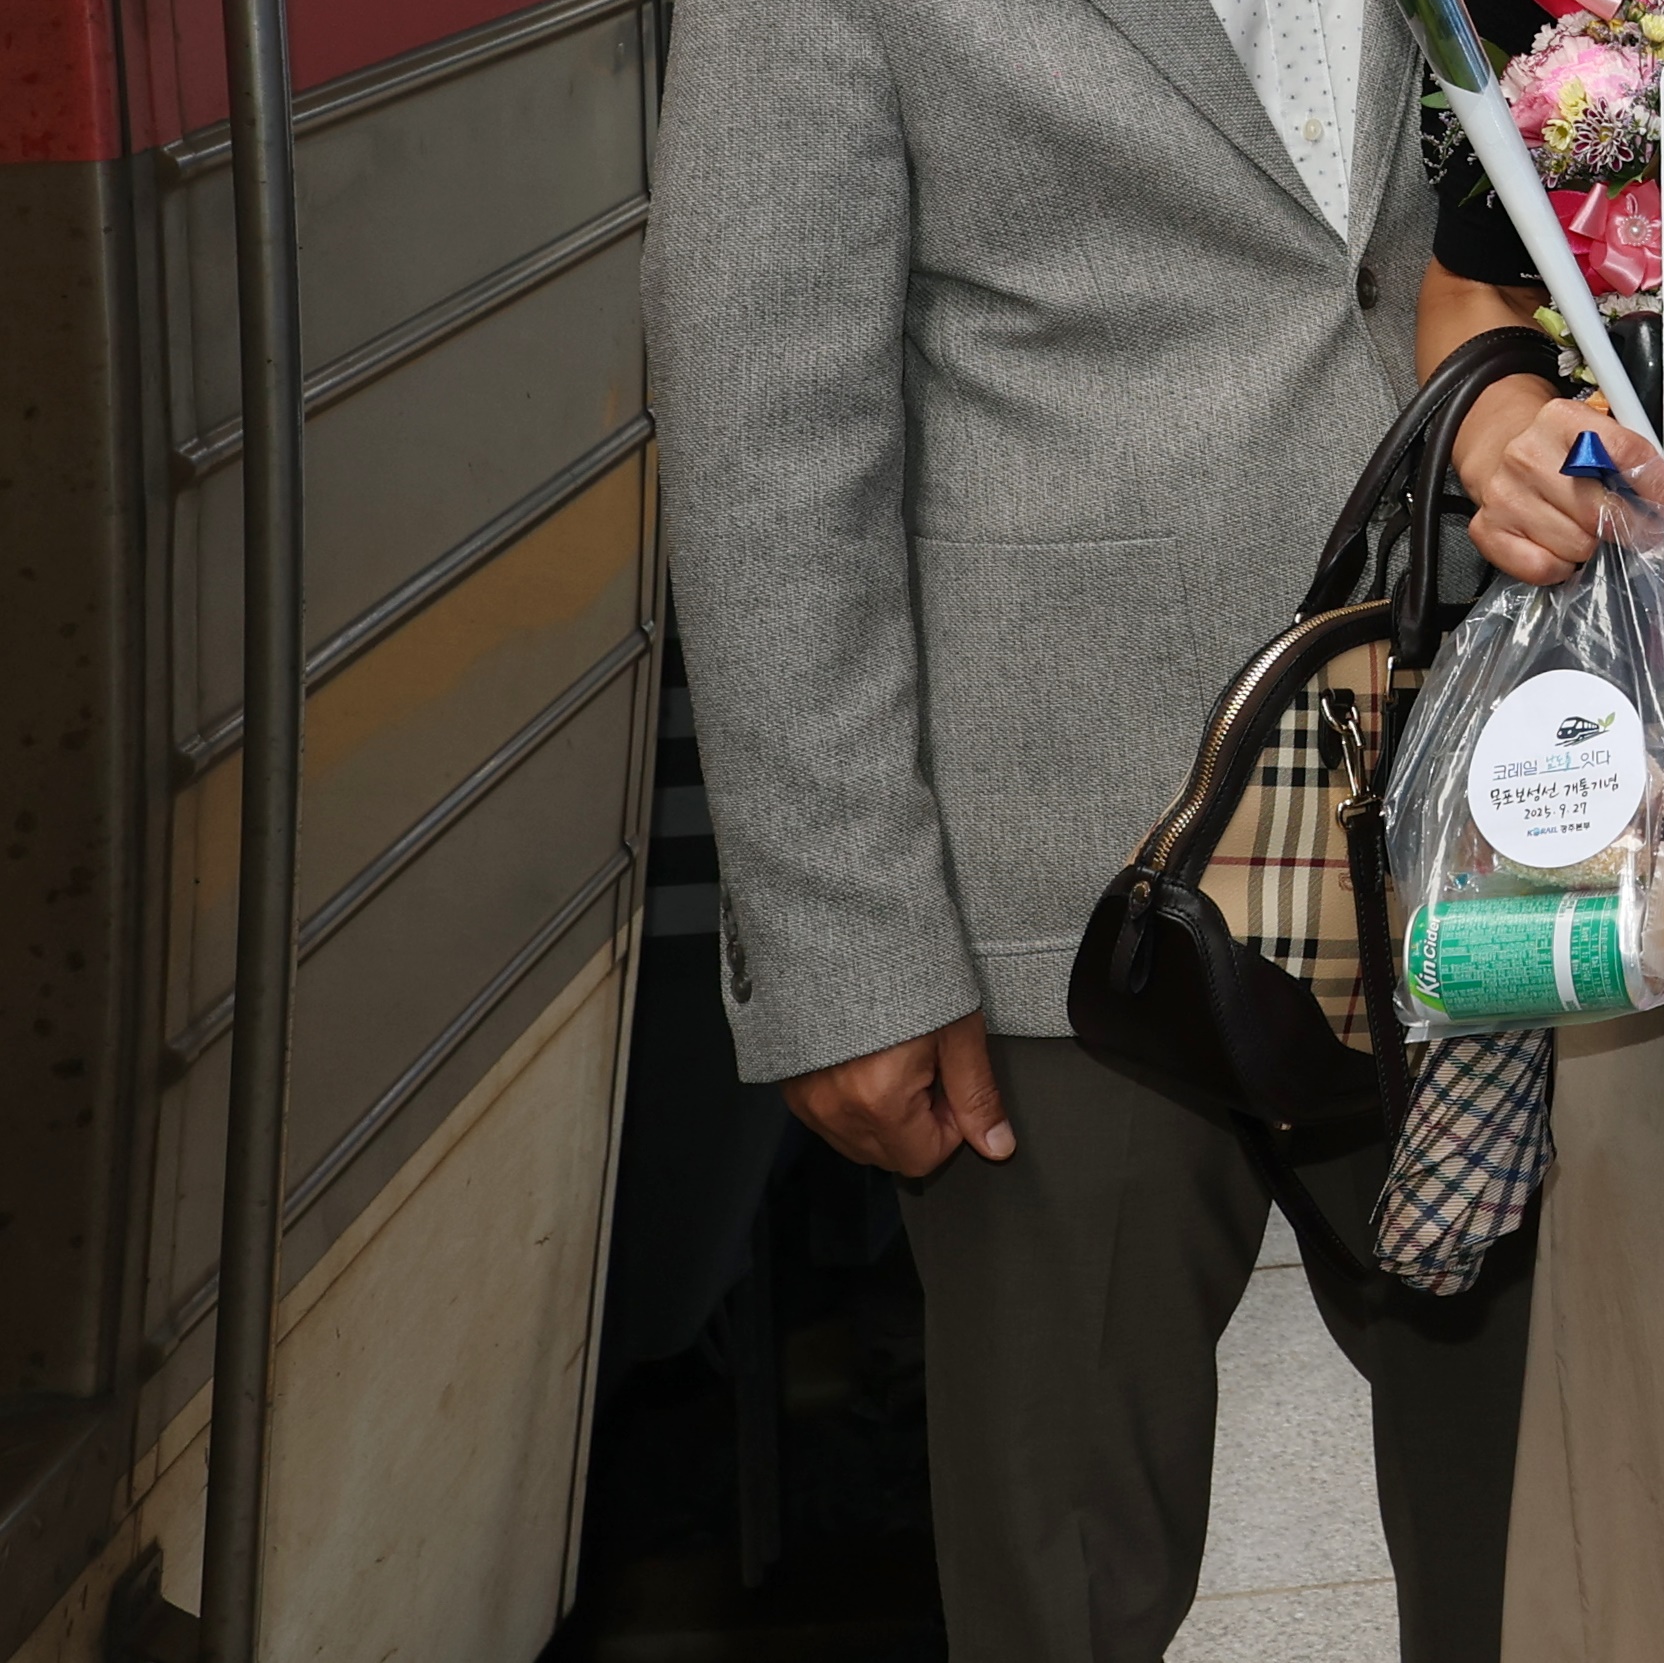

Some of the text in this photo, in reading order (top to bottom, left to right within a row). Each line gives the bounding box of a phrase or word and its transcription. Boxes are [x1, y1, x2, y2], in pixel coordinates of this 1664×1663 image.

[1492, 759, 1538, 782] 코레일
[1580, 749, 1612, 769] 잇다
[1489, 773, 1620, 810] 목포보성선 개통기념
[1415, 960, 1441, 999] Kin
